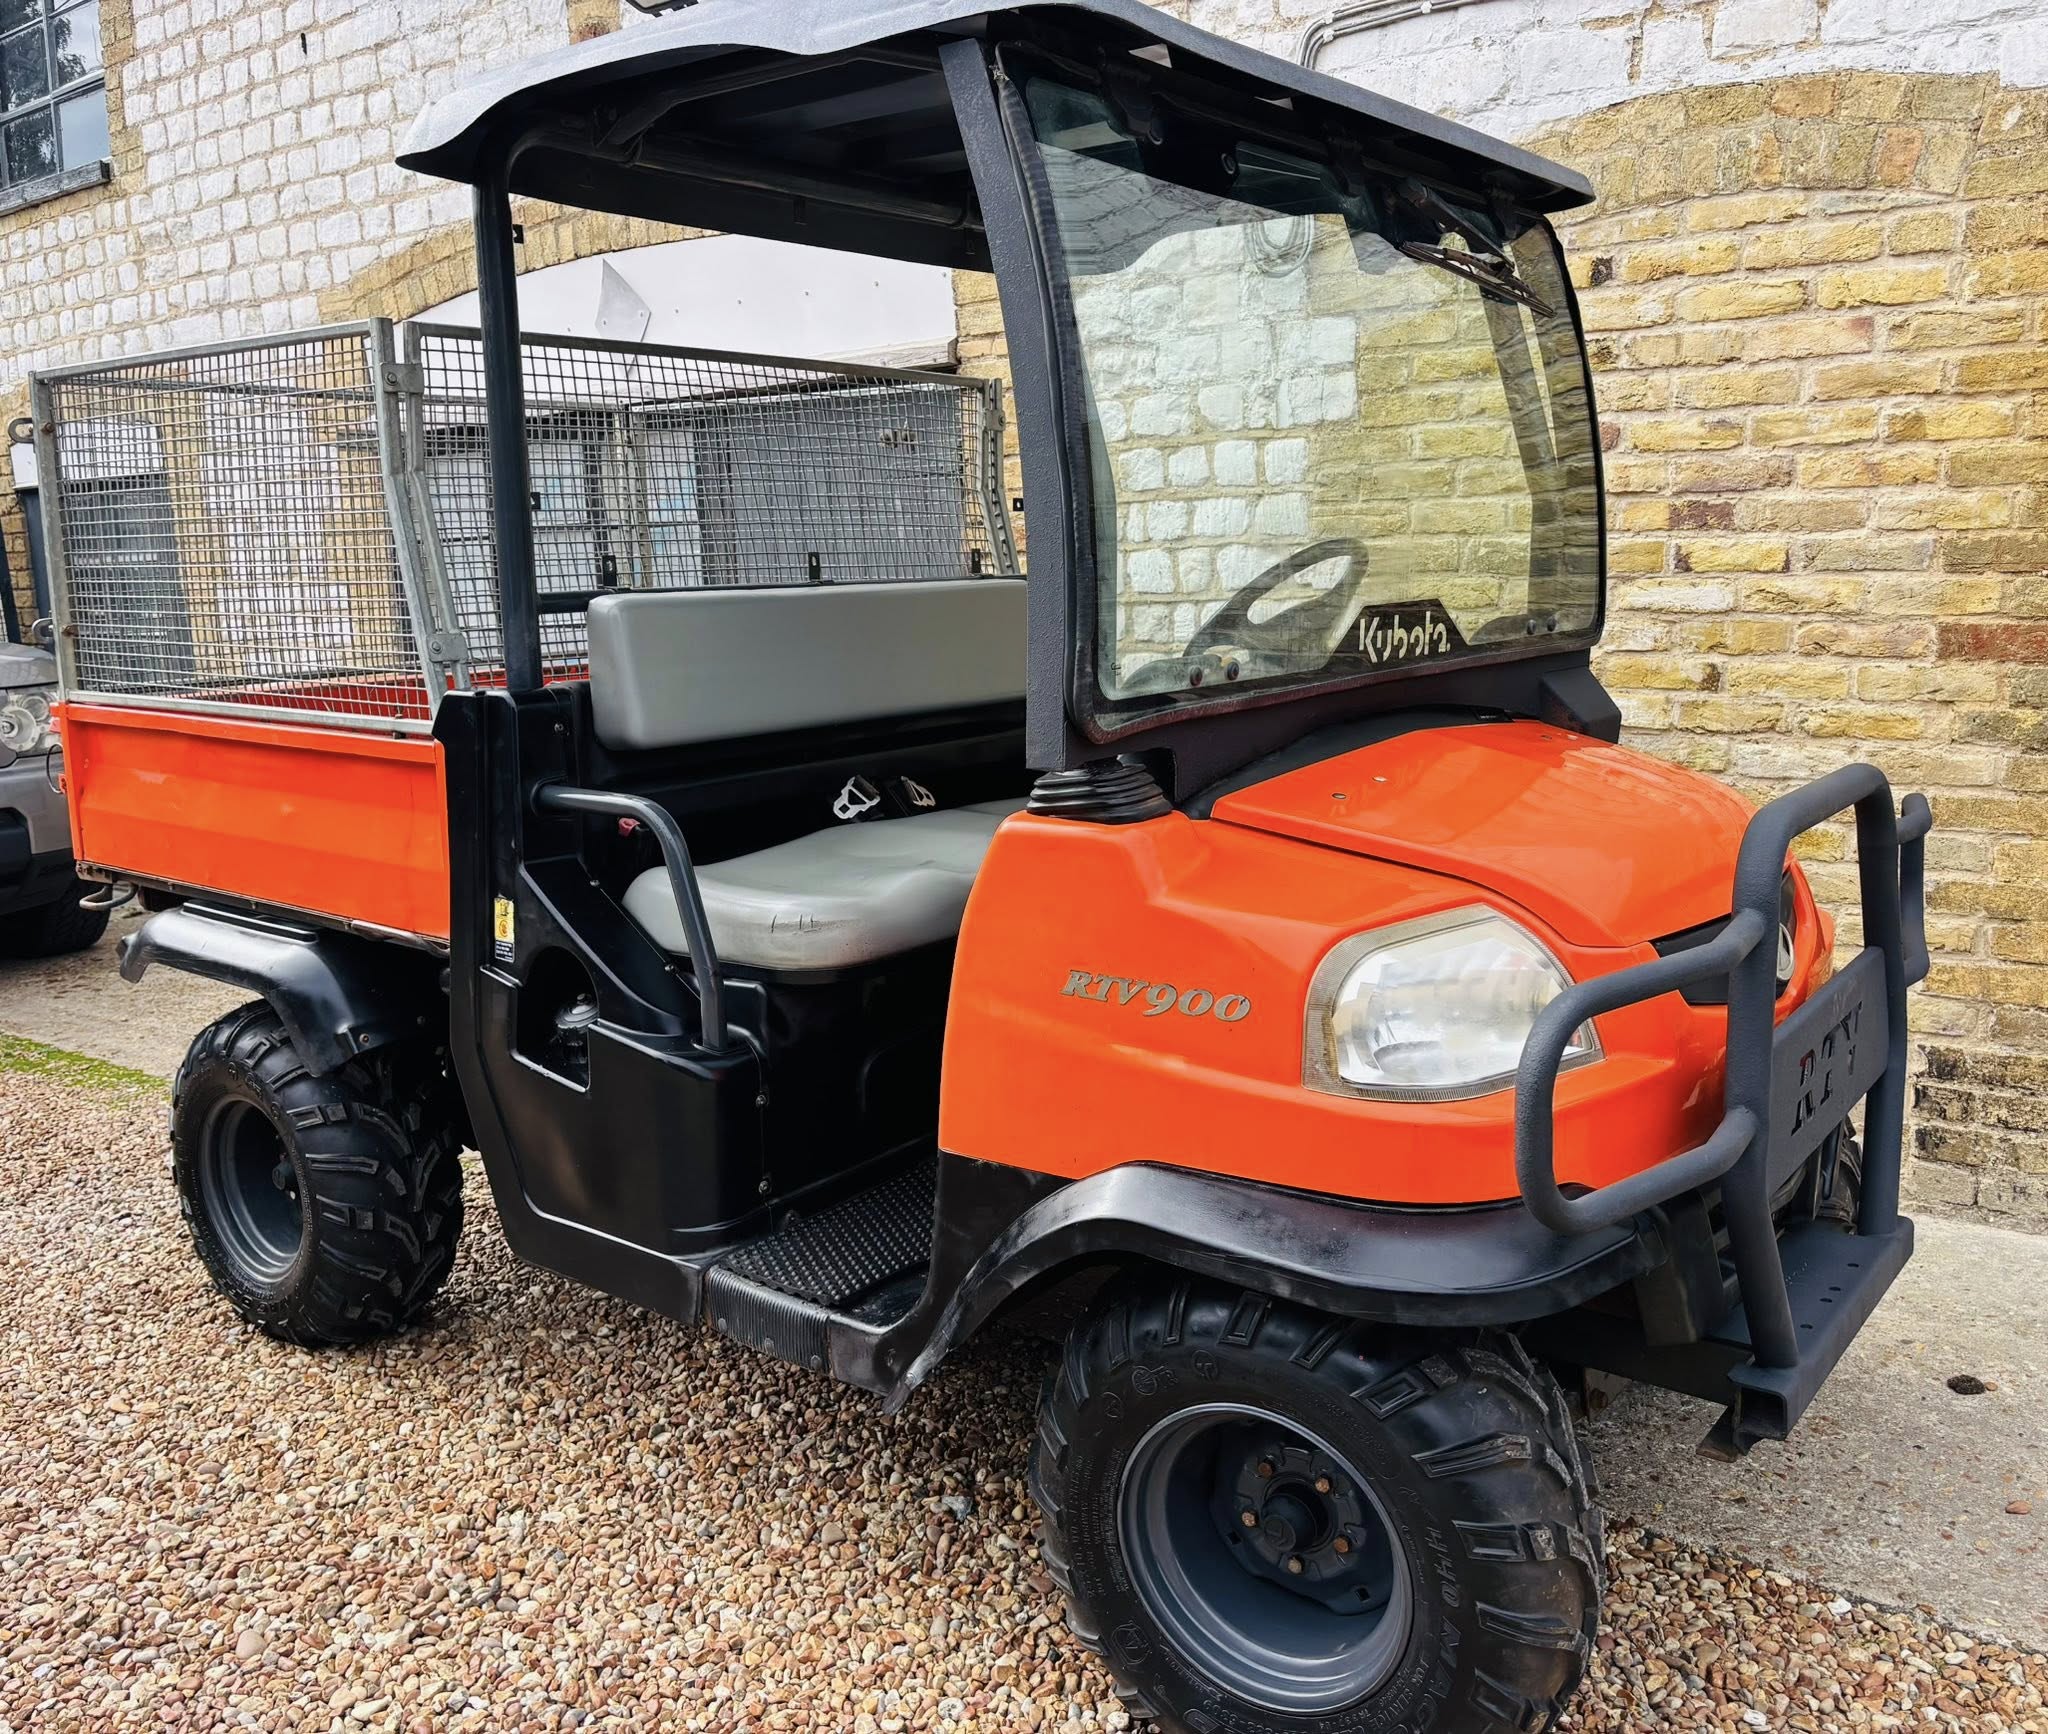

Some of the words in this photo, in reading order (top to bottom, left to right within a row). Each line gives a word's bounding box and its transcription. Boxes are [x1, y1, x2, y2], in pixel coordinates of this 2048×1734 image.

[1359, 611, 1450, 663] Kubota
[1060, 969, 1251, 1022] RTV900
[1791, 1001, 1863, 1137] RTV
